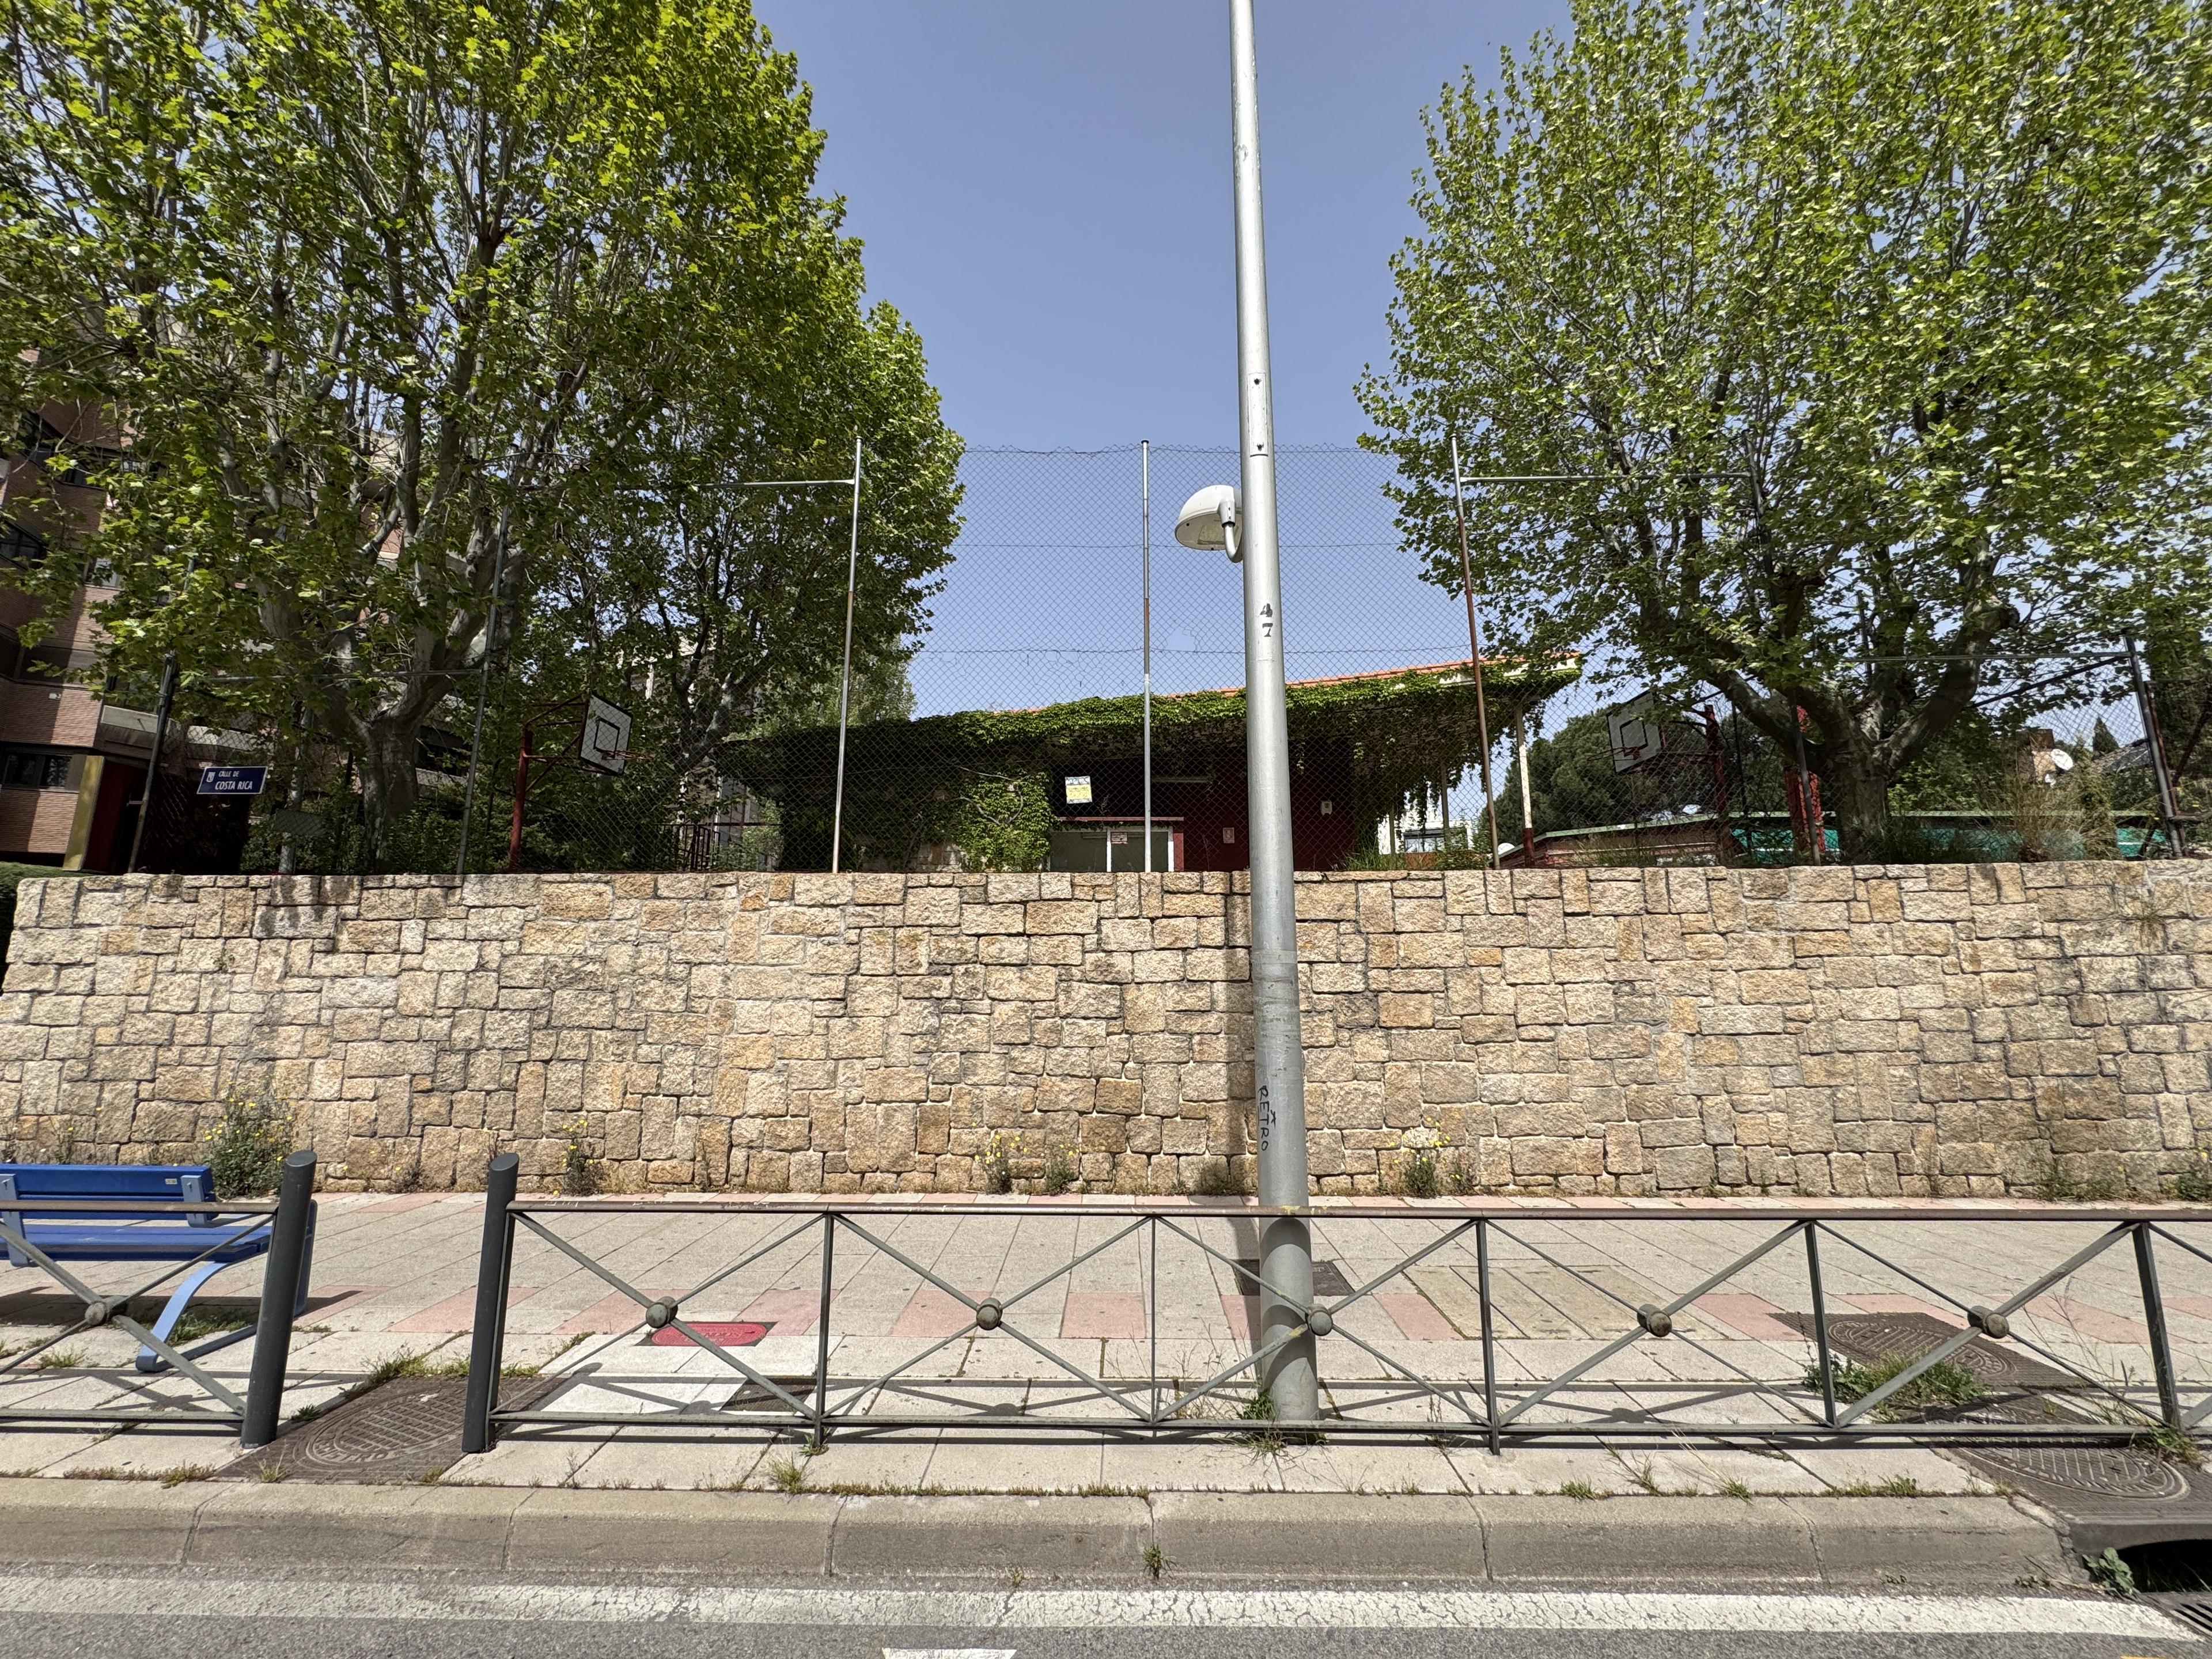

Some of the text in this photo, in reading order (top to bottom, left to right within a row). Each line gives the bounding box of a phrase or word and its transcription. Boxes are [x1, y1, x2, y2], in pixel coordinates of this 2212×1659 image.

[214, 781, 253, 790] COSTA RICA
[1258, 1085, 1270, 1152] RETRO
